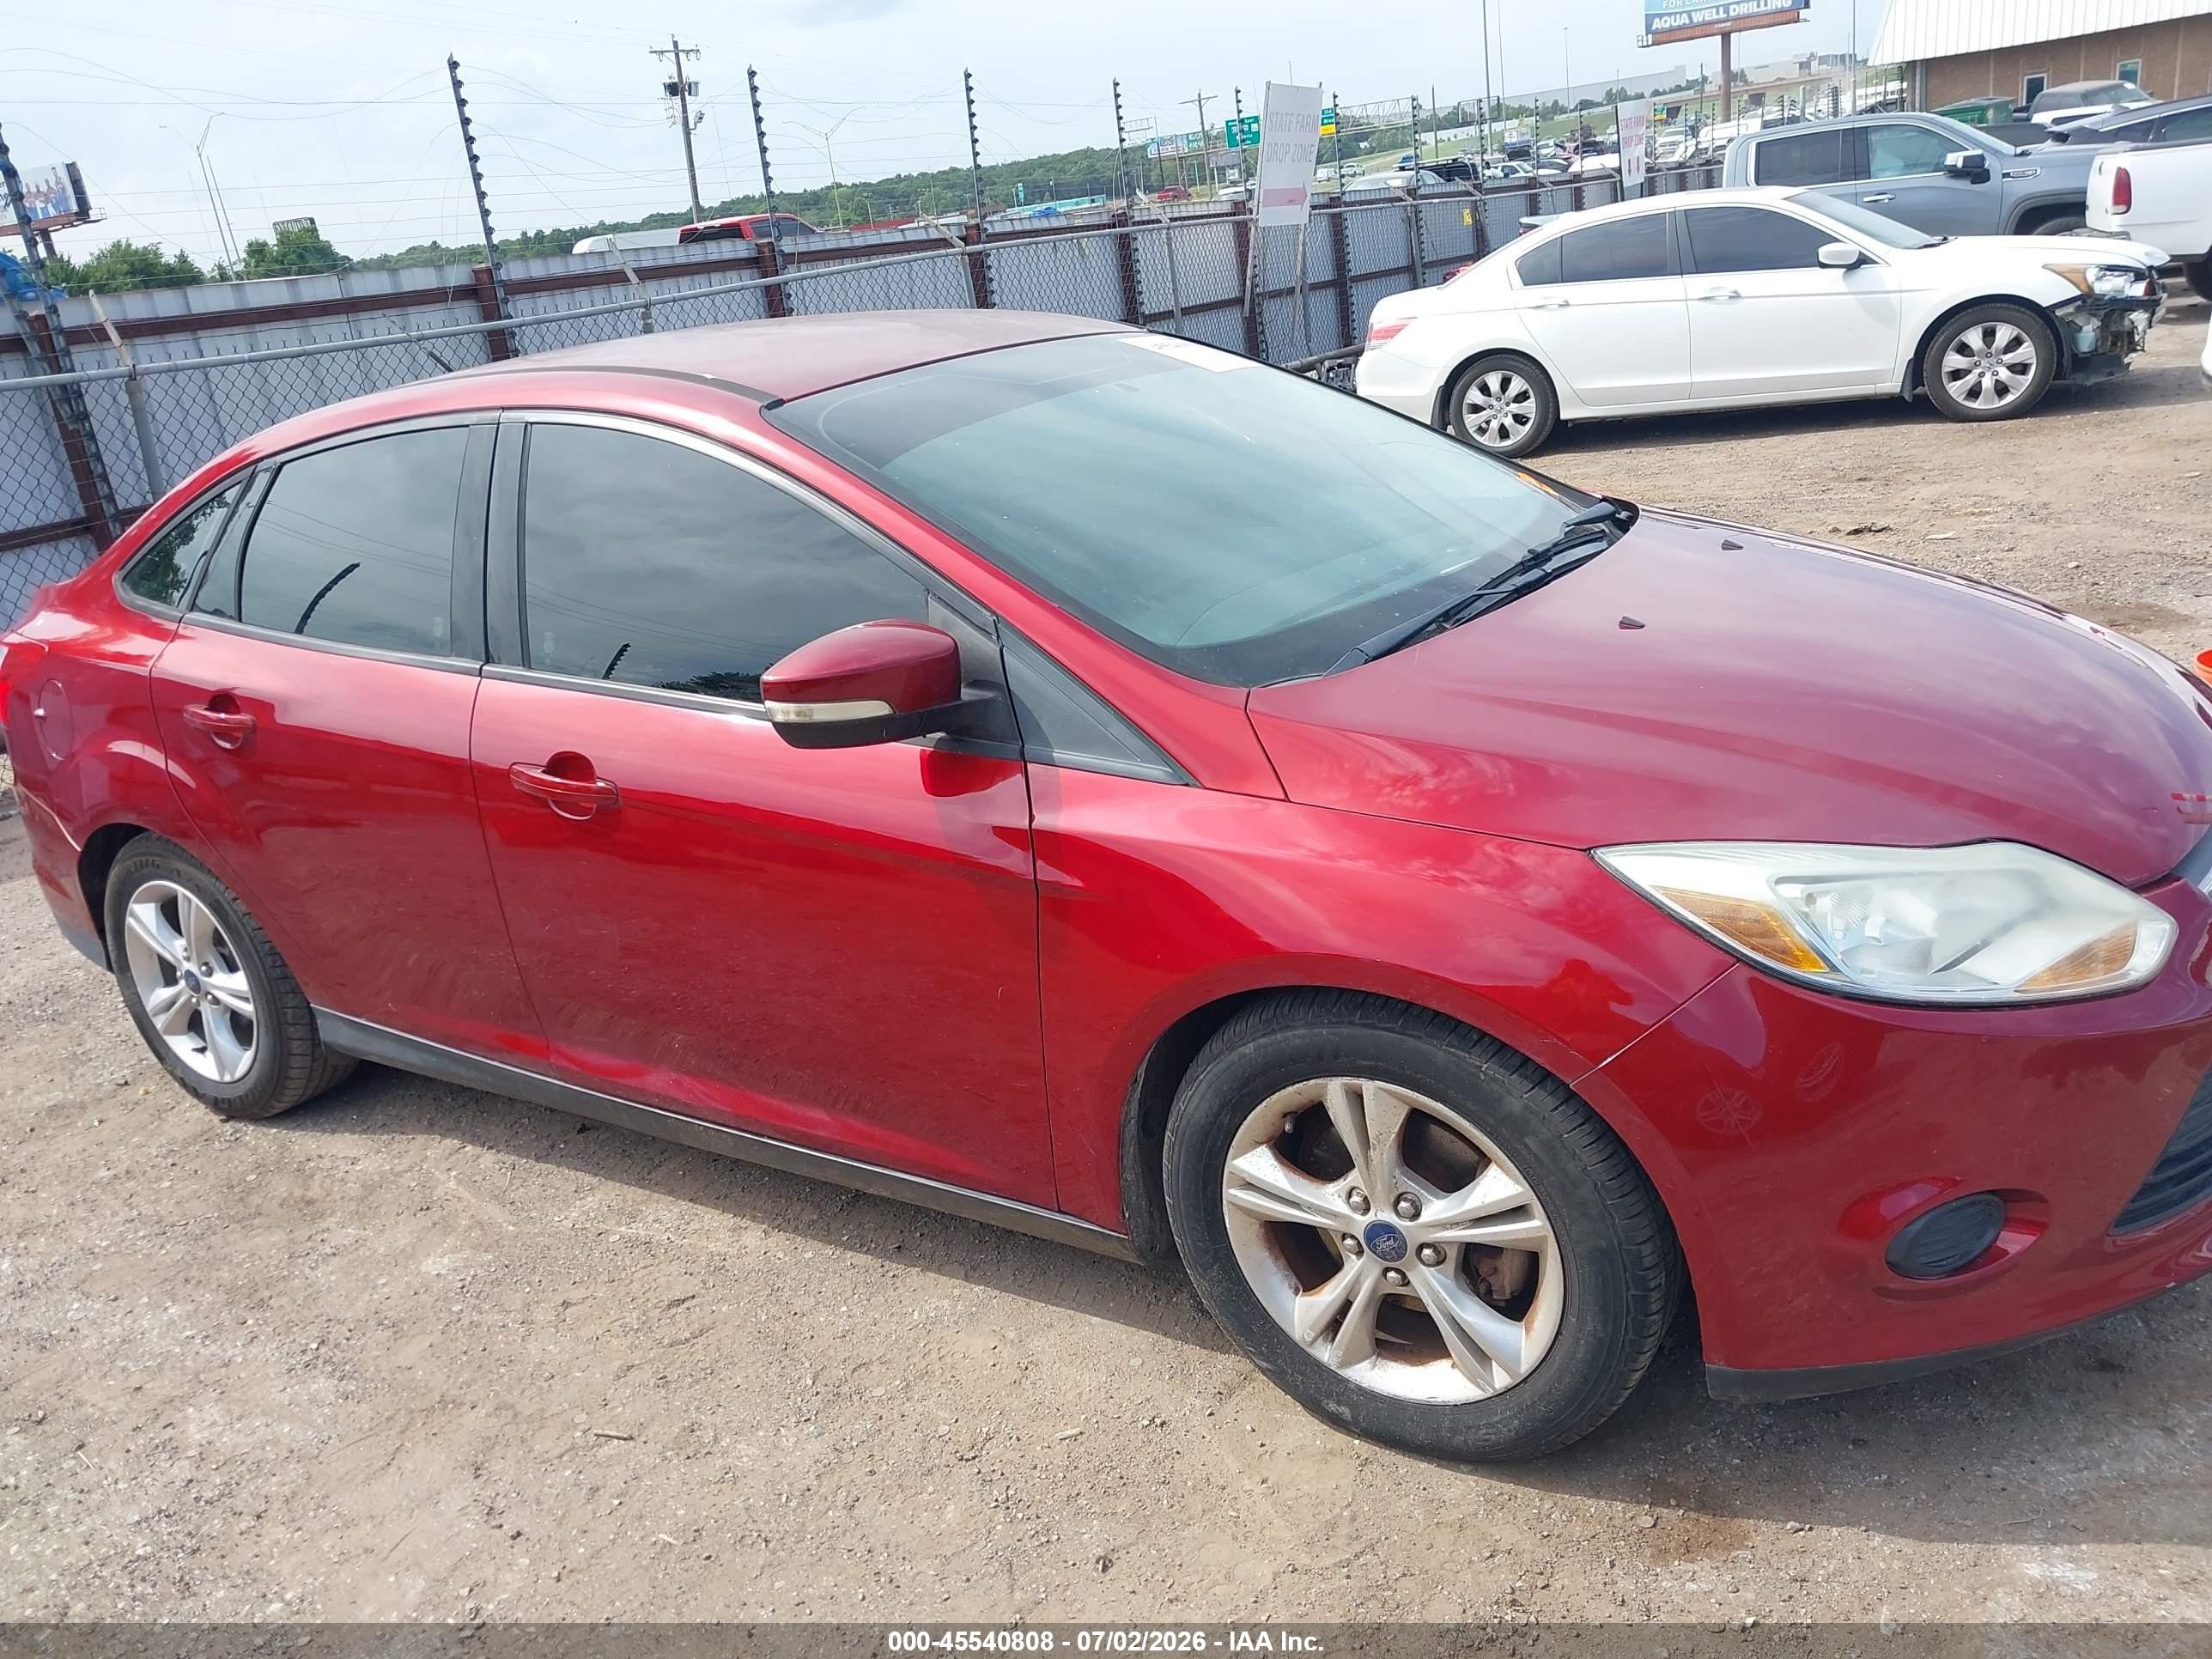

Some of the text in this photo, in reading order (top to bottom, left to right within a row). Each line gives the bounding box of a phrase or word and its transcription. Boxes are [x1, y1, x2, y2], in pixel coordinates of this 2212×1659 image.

[1652, 0, 1792, 30] AQUA WELL DRILLING
[1268, 112, 1319, 134] STATE FARM
[1620, 117, 1633, 131] STATE
[1622, 136, 1633, 149] DROP
[1267, 143, 1315, 163] DROP ZONE
[1376, 1237, 1394, 1250] Ford
